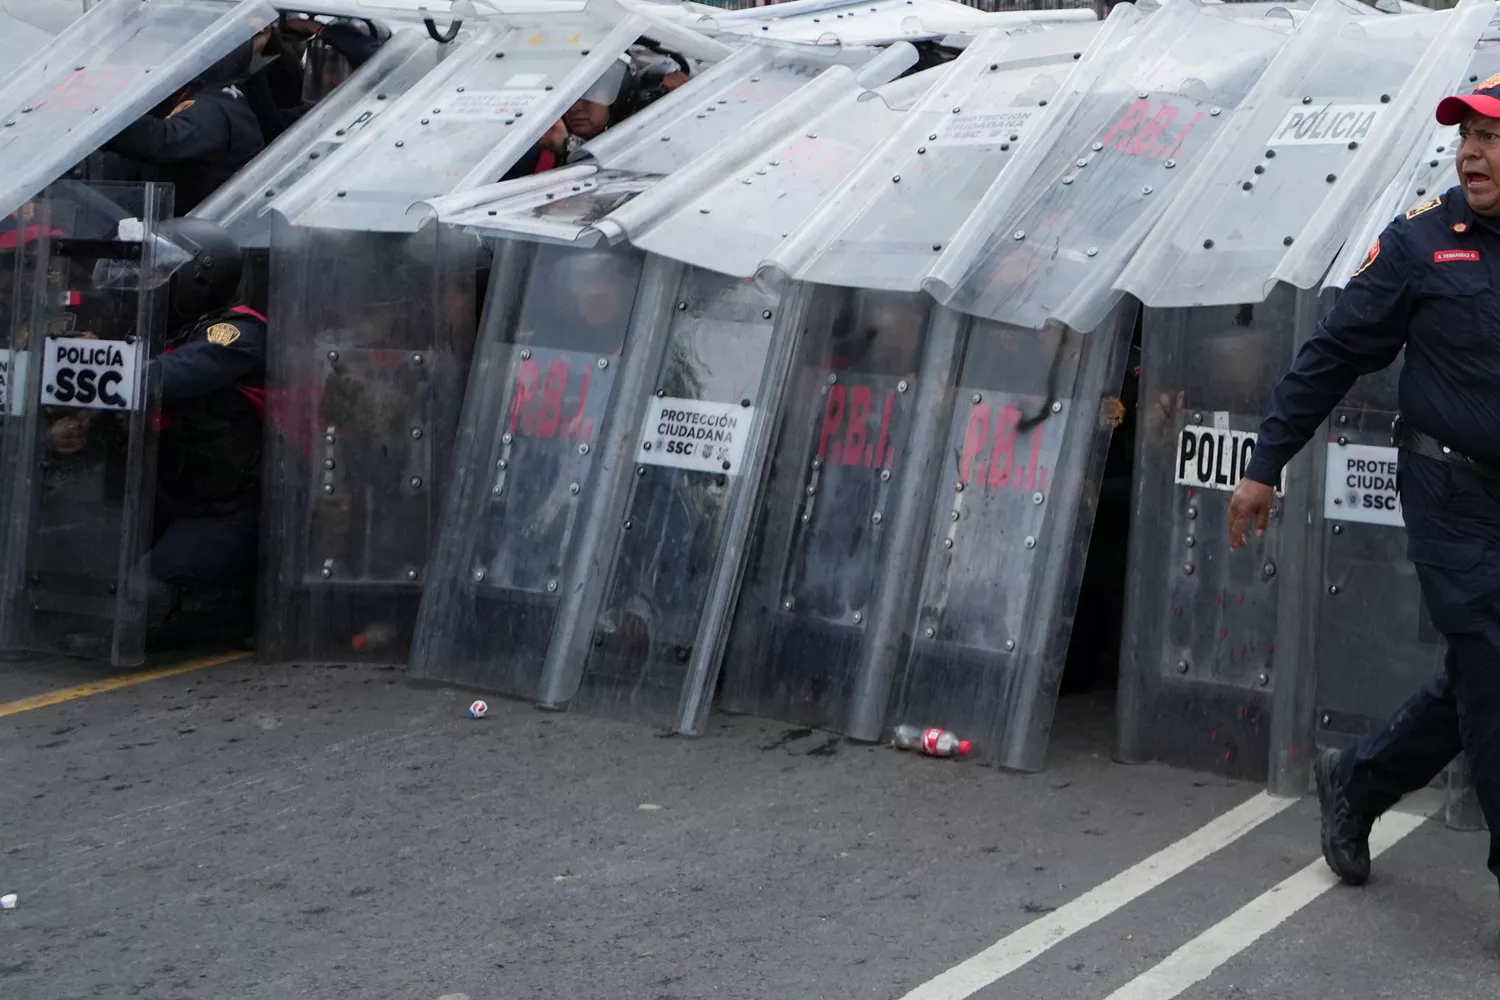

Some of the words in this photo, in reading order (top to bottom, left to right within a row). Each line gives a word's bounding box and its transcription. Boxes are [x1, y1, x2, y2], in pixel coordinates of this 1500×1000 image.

[945, 120, 1024, 130] CIUDADANA
[56, 345, 124, 366] POLICÍA
[54, 367, 124, 406] SSC
[509, 359, 596, 441] P.B.I.
[660, 408, 738, 430] PROTECCIÓN
[818, 384, 896, 469] P.B.I.
[657, 422, 733, 444] CIUDADANA
[666, 440, 694, 456] SSC
[962, 402, 1048, 491] P.B.I.
[1346, 458, 1398, 475] PROTE
[1346, 474, 1397, 492] CIUDA
[1362, 494, 1396, 511] SSC
